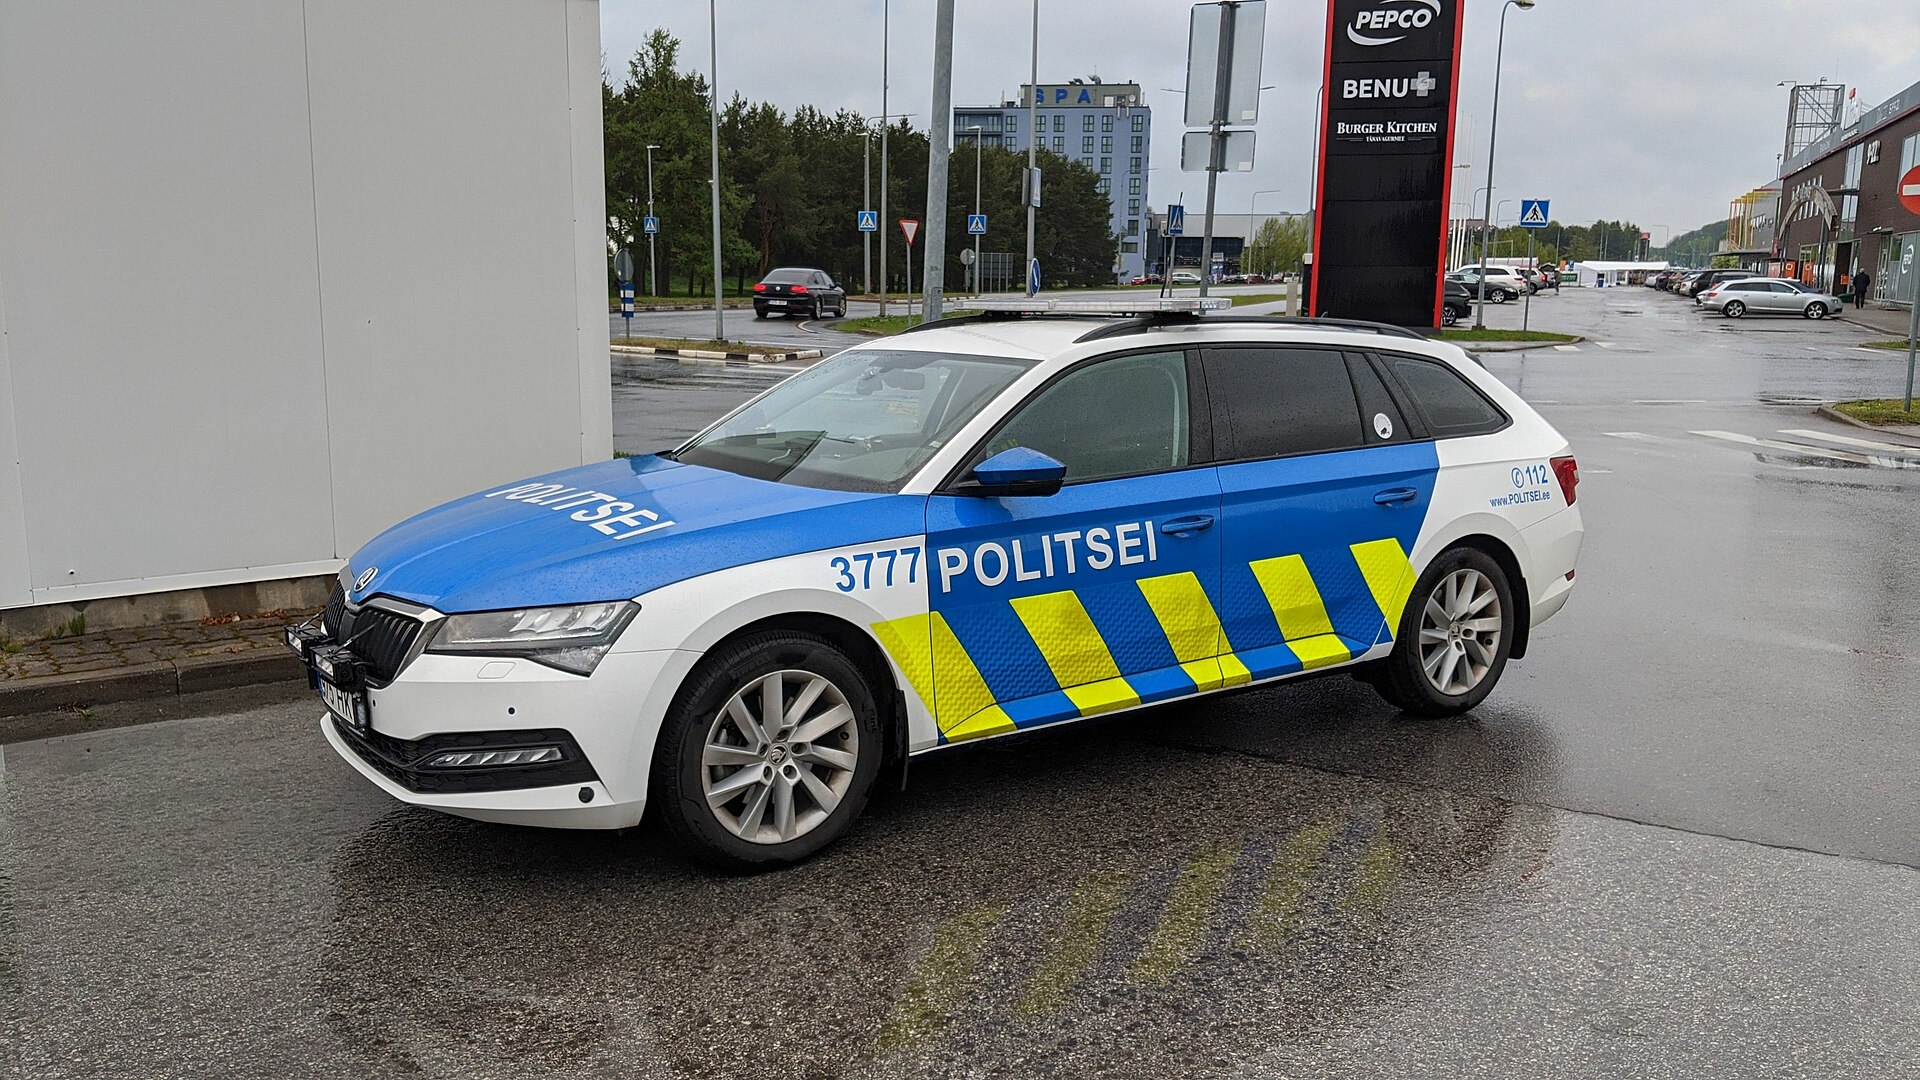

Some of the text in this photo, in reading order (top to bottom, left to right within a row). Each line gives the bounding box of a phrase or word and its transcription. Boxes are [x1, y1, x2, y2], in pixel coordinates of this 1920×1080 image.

[1355, 9, 1432, 29] PEPCO
[1035, 88, 1091, 104] SPA
[1343, 78, 1409, 99] BENU
[1525, 465, 1548, 485] 112
[1489, 490, 1550, 506] www.POLITSEI.ee
[485, 483, 676, 540] POLITSEI
[937, 520, 1158, 593] POLITSEI
[830, 546, 922, 593] 3777
